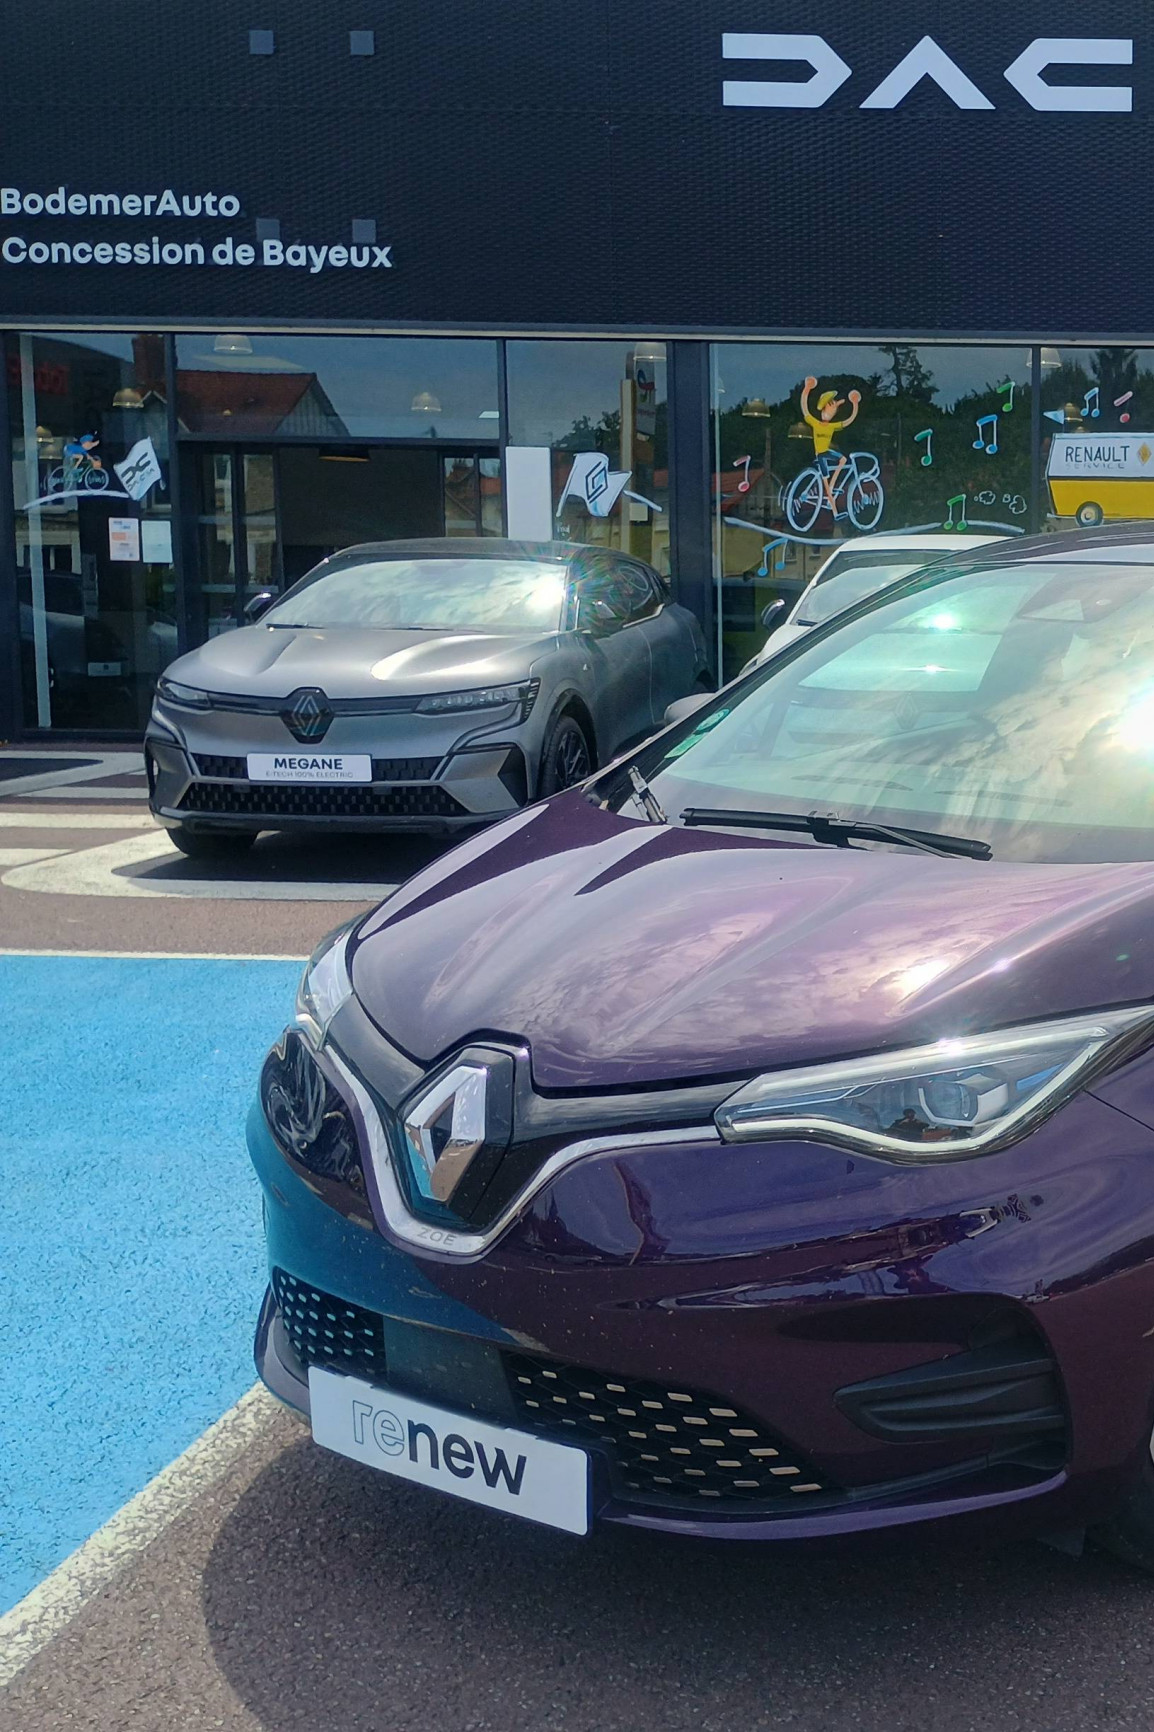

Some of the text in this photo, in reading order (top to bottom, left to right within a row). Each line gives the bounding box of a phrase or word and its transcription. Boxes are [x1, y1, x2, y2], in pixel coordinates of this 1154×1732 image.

[0, 187, 241, 217] BodemerAuto
[2, 236, 392, 274] Concession de Bayeux
[1065, 445, 1130, 463] RENAULT
[274, 758, 343, 770] MEGANE
[295, 771, 315, 779] 100%
[417, 1226, 457, 1246] ZOE
[352, 1399, 527, 1496] renew
